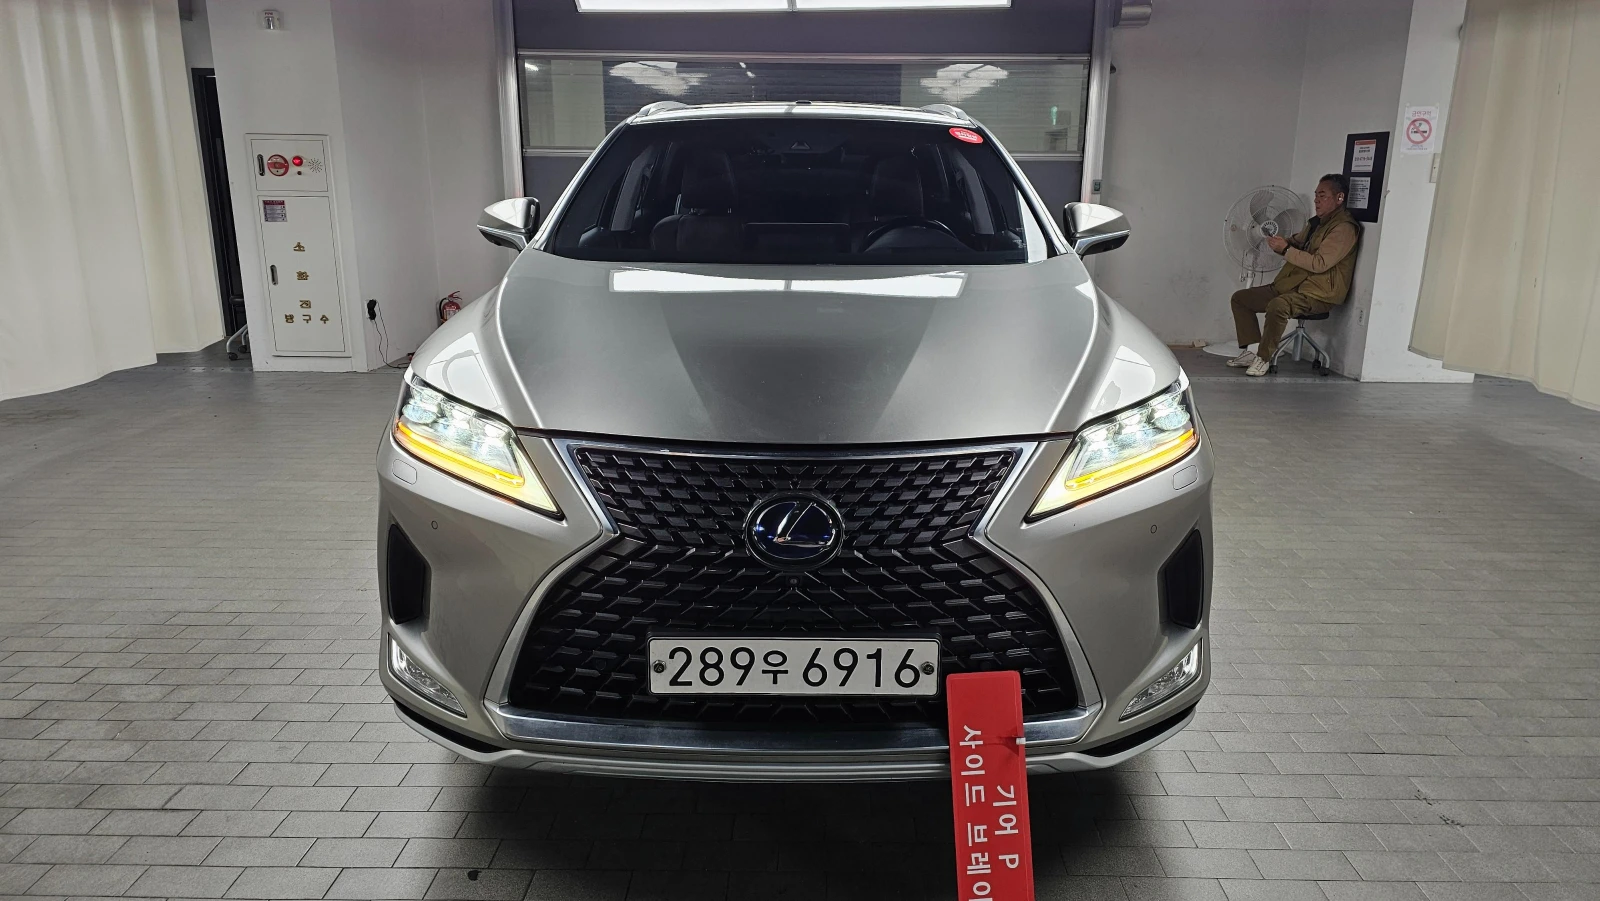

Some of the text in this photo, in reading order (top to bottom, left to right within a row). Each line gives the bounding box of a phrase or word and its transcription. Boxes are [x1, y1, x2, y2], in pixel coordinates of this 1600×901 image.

[668, 646, 921, 688] 289우 6916
[959, 724, 986, 807] 사이드
[992, 784, 1019, 869] 기어 P
